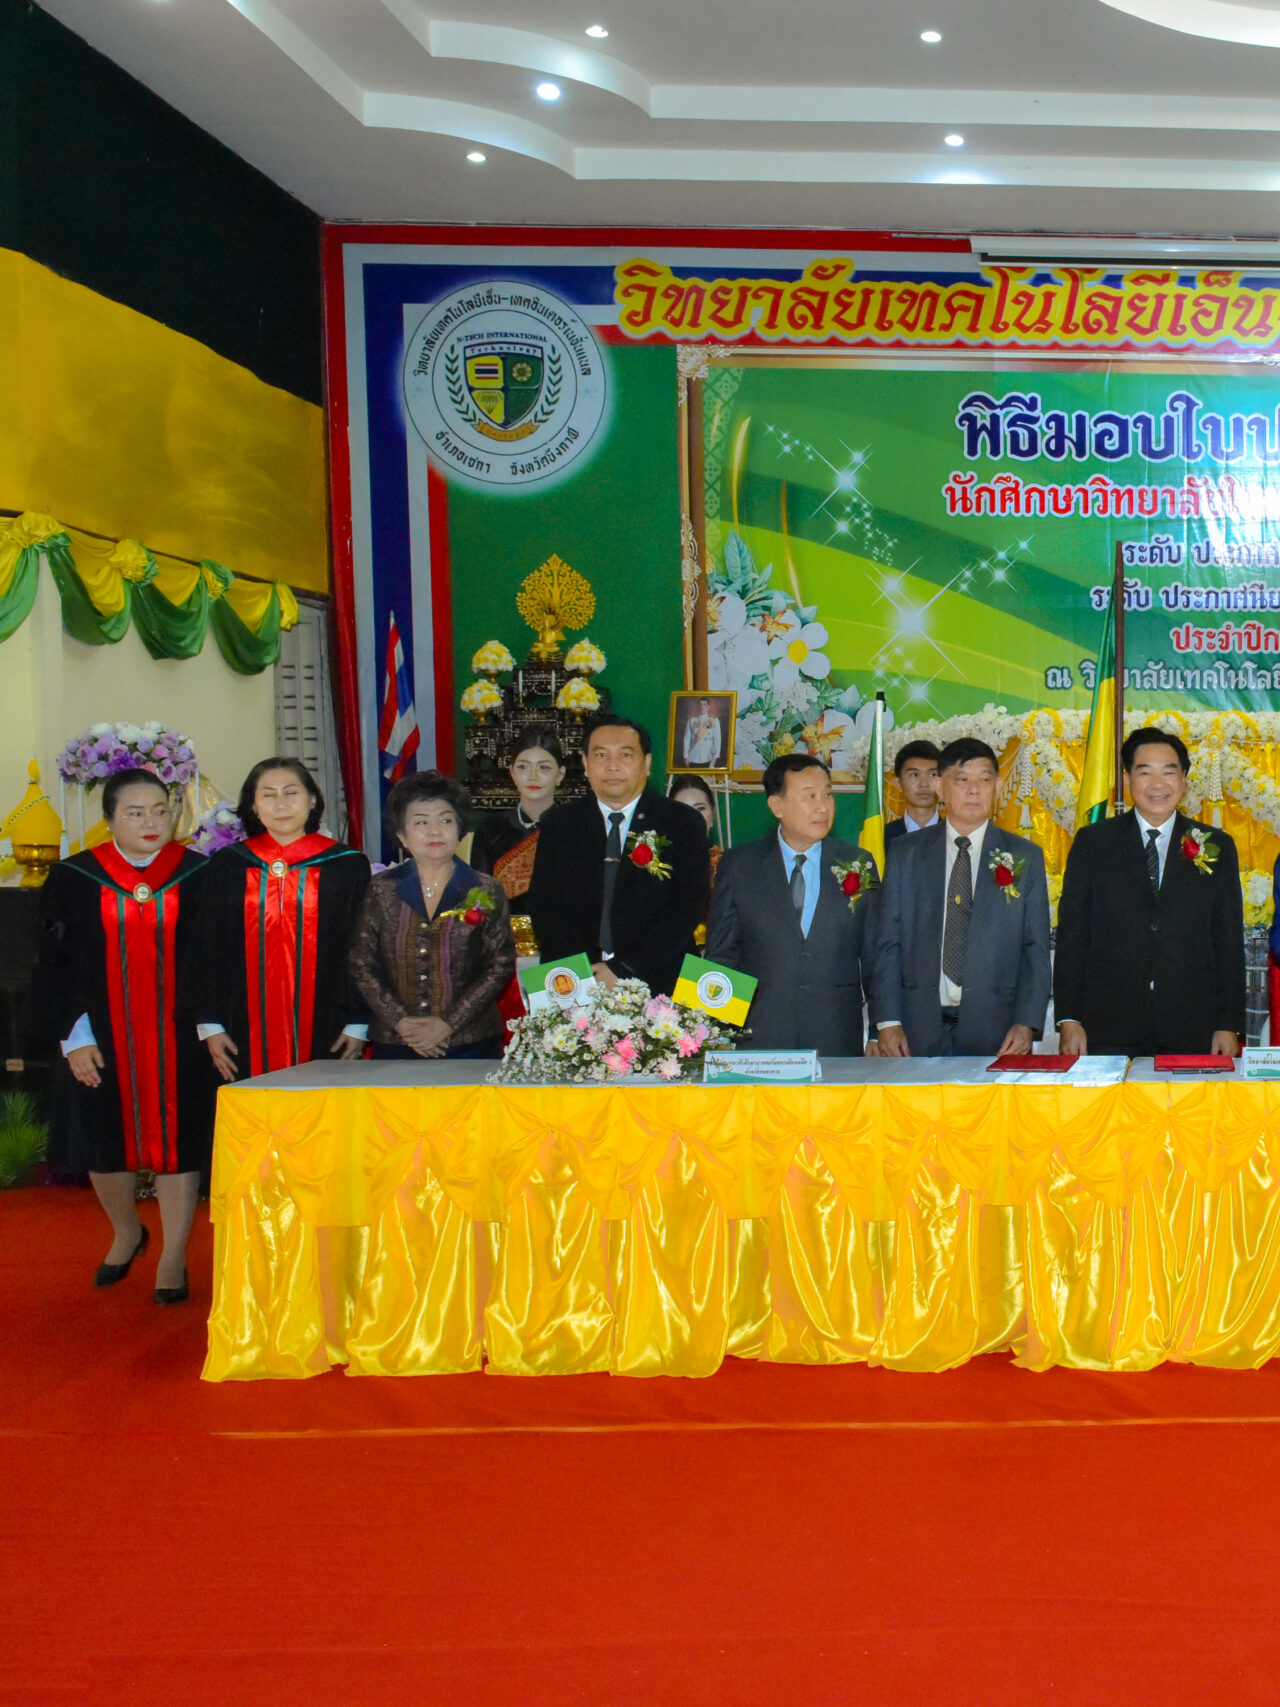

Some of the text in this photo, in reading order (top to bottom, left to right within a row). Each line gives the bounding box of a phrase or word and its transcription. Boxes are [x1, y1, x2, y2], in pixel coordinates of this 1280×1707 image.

[486, 332, 548, 343] INTERNATIONAL
[1124, 537, 1181, 563] ระดับ
[1046, 667, 1072, 689] ณ
